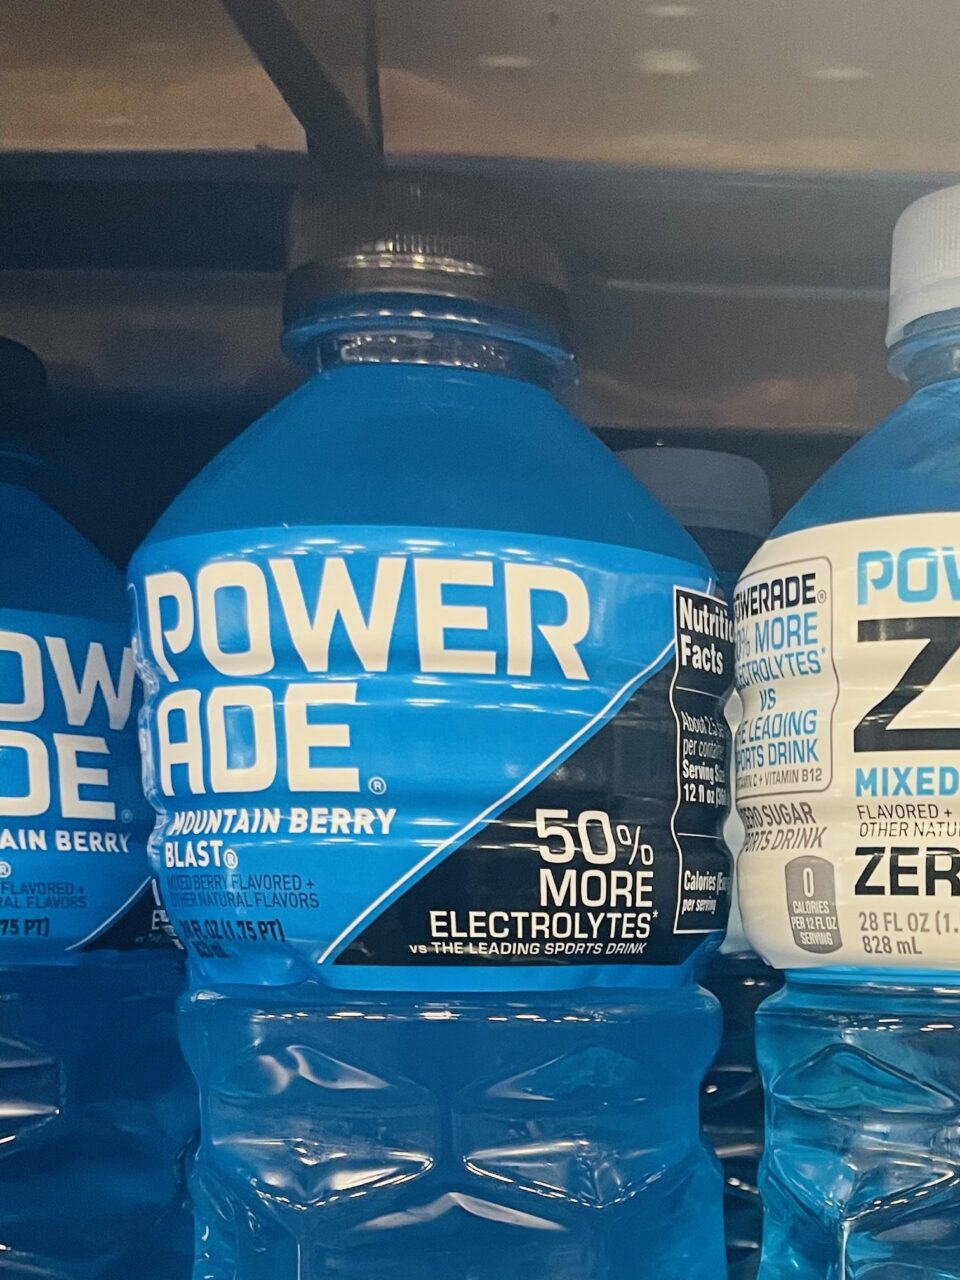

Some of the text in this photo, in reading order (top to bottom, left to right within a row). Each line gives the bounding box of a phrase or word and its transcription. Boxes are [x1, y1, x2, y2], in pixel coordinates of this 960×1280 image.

[145, 557, 591, 682] POWER
[679, 596, 736, 644] Nutritio
[755, 611, 819, 654] MORE
[679, 634, 724, 675] Facts
[760, 688, 777, 712] VS
[748, 709, 819, 742] LEADING
[768, 739, 821, 769] DRINK
[764, 770, 800, 787] VITAMIN
[801, 768, 823, 782] B12
[854, 766, 960, 797] MIXED
[683, 783, 696, 802] 12
[167, 808, 397, 836] MOUNTAIN BERRY
[765, 802, 817, 829] SUGAR
[857, 804, 940, 820] FLAVORED
[55, 831, 131, 853] BERRY
[535, 808, 654, 865] 50%
[772, 827, 828, 851] DRINK
[859, 822, 909, 838] OTHER
[232, 874, 303, 891] FLAVORED
[539, 868, 654, 907] MORE
[683, 870, 717, 892] Calories
[802, 867, 815, 898] 0
[255, 892, 320, 909] FLAVORS
[792, 900, 830, 914] CALORIES
[257, 919, 286, 943] PT)
[858, 911, 879, 932] 28
[884, 912, 903, 932] FL
[907, 912, 930, 933] OZ
[409, 942, 647, 955] vs THE LEADING SPORTS DRINK
[800, 931, 834, 946] SERVING
[863, 935, 923, 955] 828 mL
